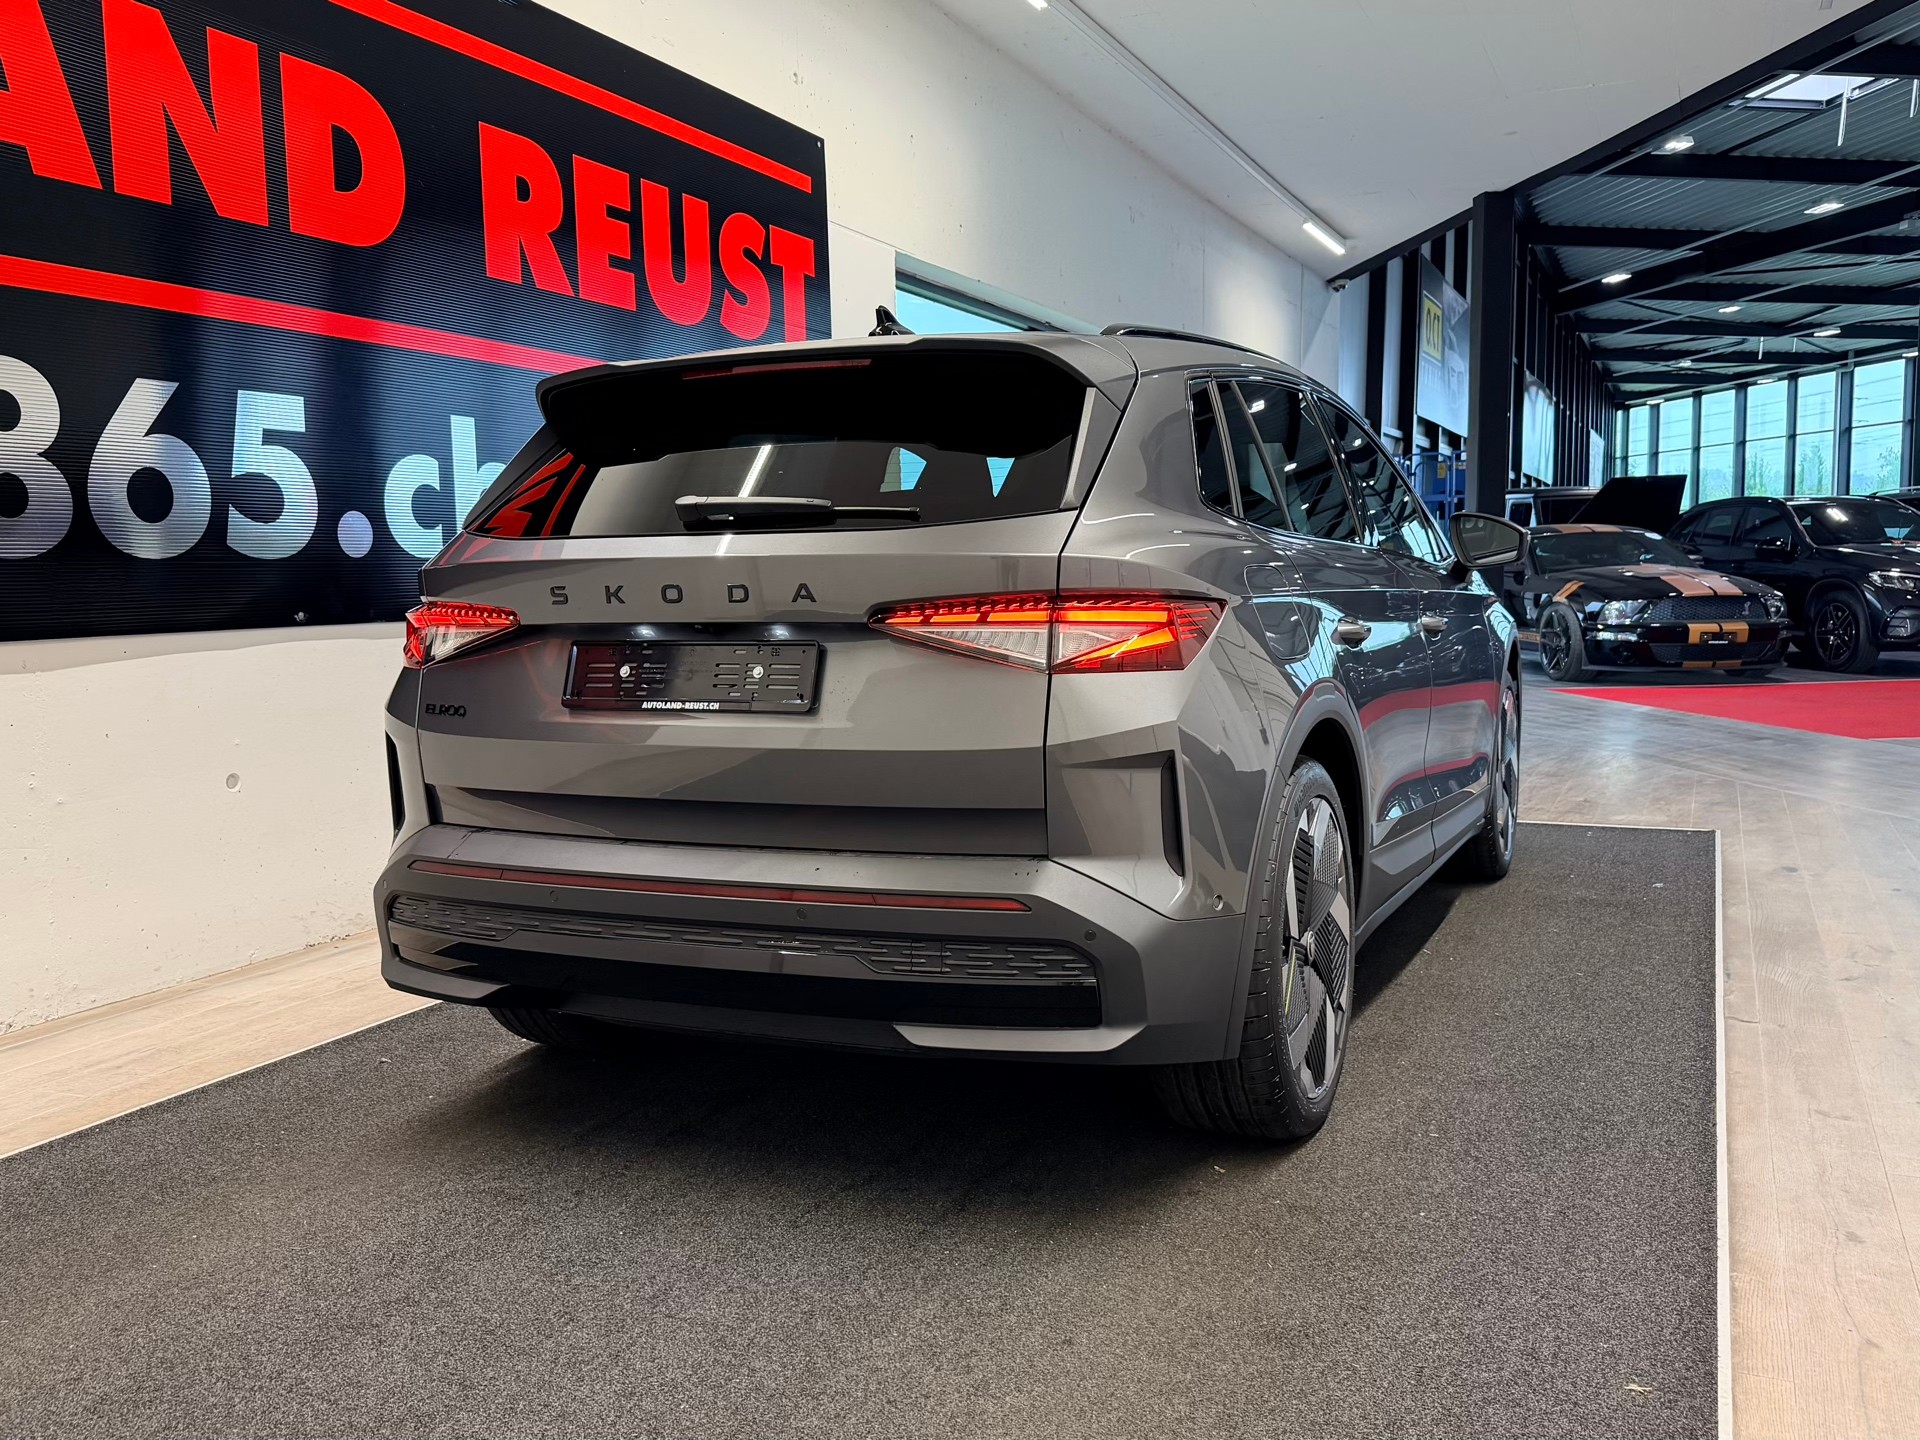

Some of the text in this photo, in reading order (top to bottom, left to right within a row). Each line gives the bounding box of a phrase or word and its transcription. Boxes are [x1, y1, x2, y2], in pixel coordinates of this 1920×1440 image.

[478, 121, 816, 343] REUST
[550, 582, 818, 606] SKODA
[425, 703, 467, 718] ELROQ
[641, 701, 720, 710] AUTOLAND-REUST.CH
